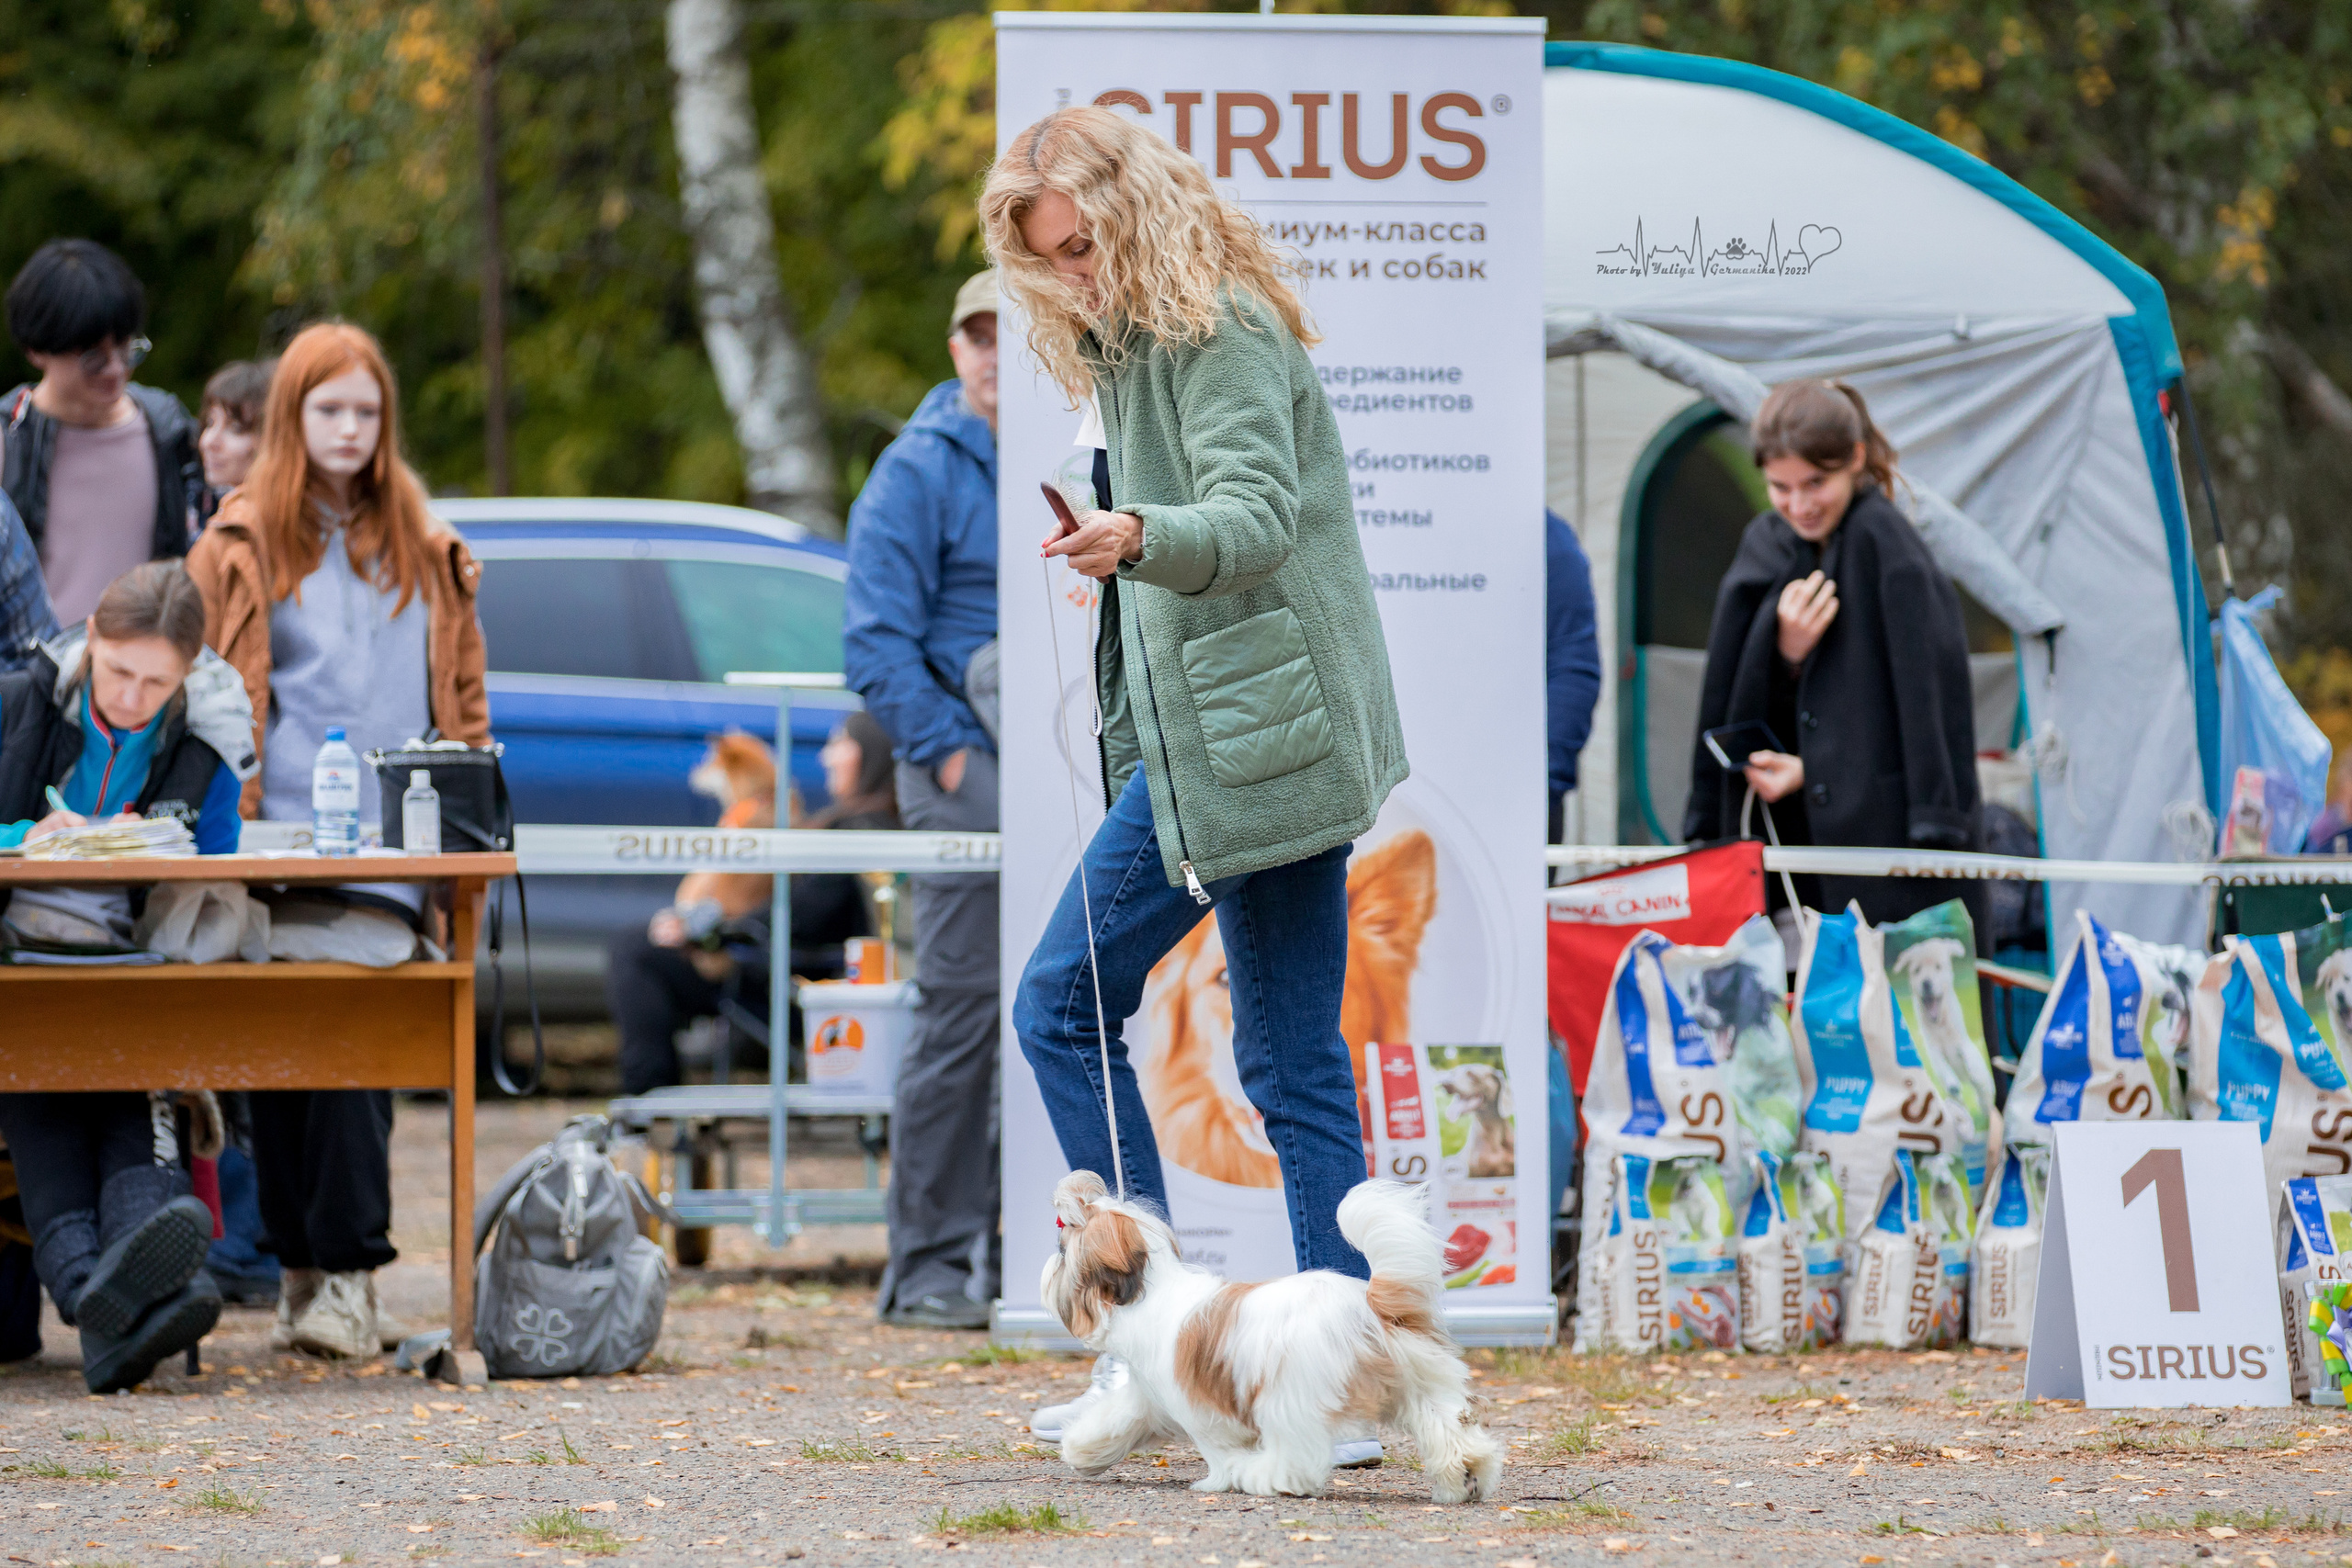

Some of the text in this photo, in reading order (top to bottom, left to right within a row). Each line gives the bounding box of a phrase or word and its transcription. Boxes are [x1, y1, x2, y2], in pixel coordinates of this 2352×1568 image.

[1091, 90, 1487, 182] IRIUS
[1351, 261, 1370, 278] и
[1384, 253, 1486, 279] собак
[1355, 509, 1433, 527] темы
[2120, 1148, 2200, 1312] 1
[1634, 1230, 1663, 1341] SIRIUS
[1990, 1242, 2007, 1319] SIRIUS
[2108, 1345, 2267, 1380] SIRIUS
